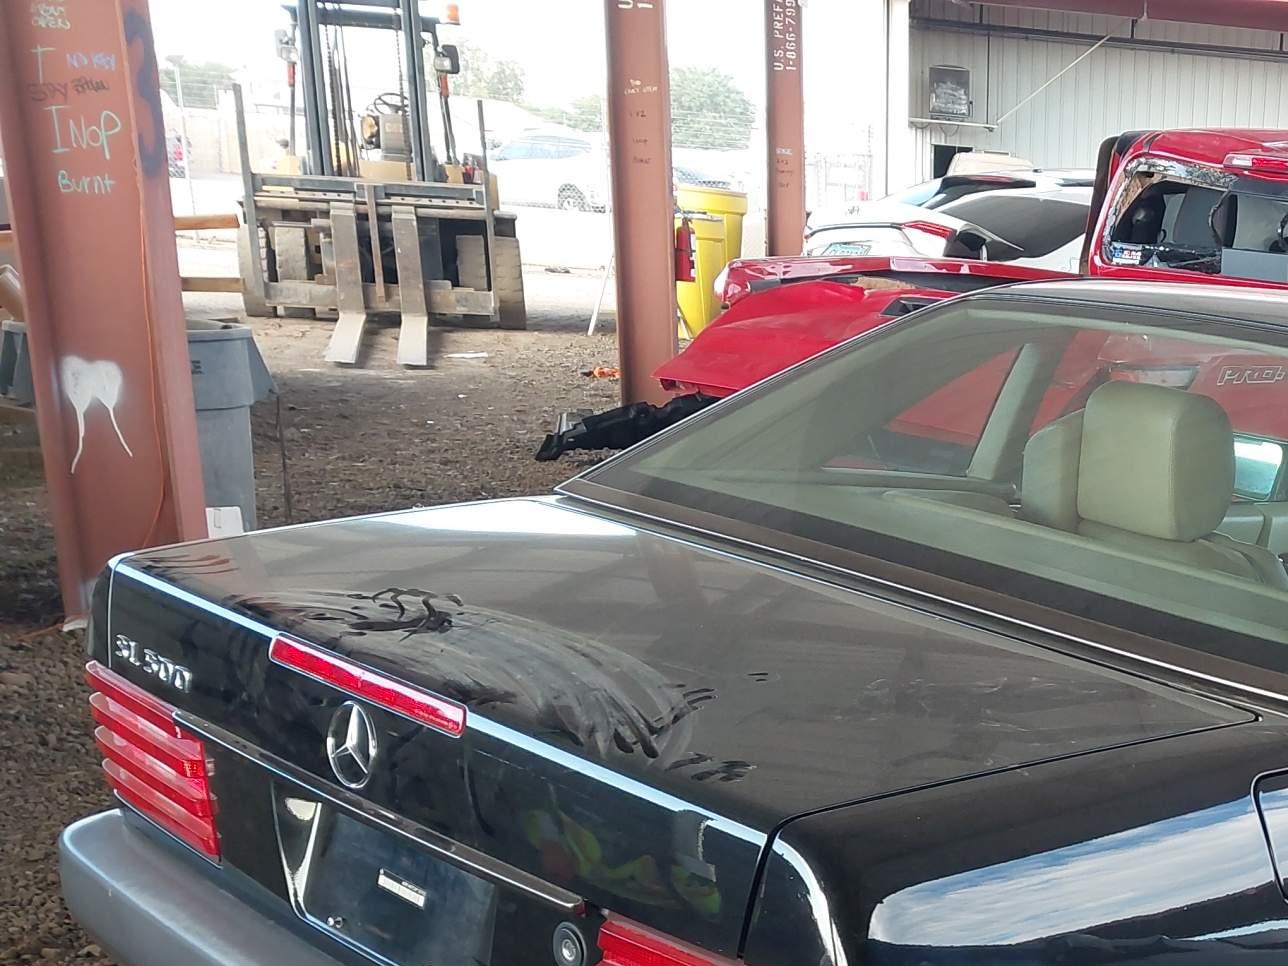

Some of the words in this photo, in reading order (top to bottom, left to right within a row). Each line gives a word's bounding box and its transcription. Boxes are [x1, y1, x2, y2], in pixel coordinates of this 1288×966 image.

[773, 0, 784, 38] PREF
[58, 170, 116, 194] Burnt
[115, 634, 142, 666] SL
[143, 648, 193, 693] 500
